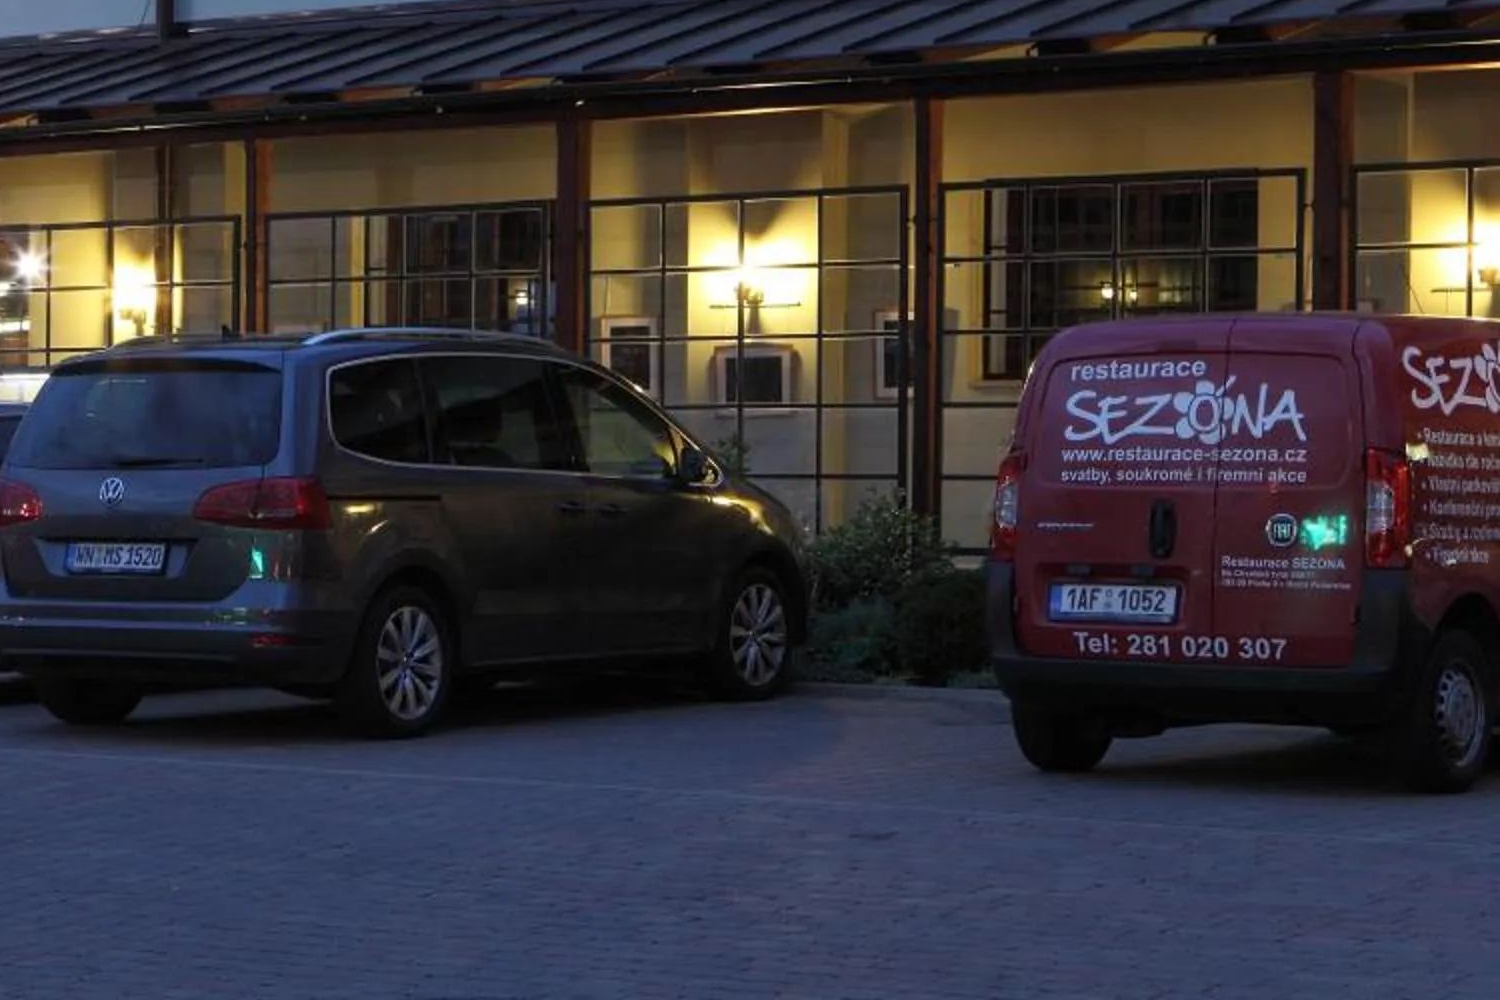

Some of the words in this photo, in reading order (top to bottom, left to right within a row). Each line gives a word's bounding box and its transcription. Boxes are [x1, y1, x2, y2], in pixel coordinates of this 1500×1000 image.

[1070, 360, 1206, 381] restaurace
[1061, 448, 1307, 463] www.restaurace-sezona.cz
[1061, 467, 1110, 487] svatby,
[1117, 467, 1192, 482] soukromé
[1267, 468, 1307, 483] akce
[1221, 555, 1290, 569] Restaurace
[1067, 588, 1102, 611] 1AF
[1118, 588, 1166, 613] 1052
[1072, 631, 1118, 654] Tel:
[1127, 634, 1170, 656] 281
[1181, 636, 1229, 659] 020
[1238, 638, 1287, 660] 307
